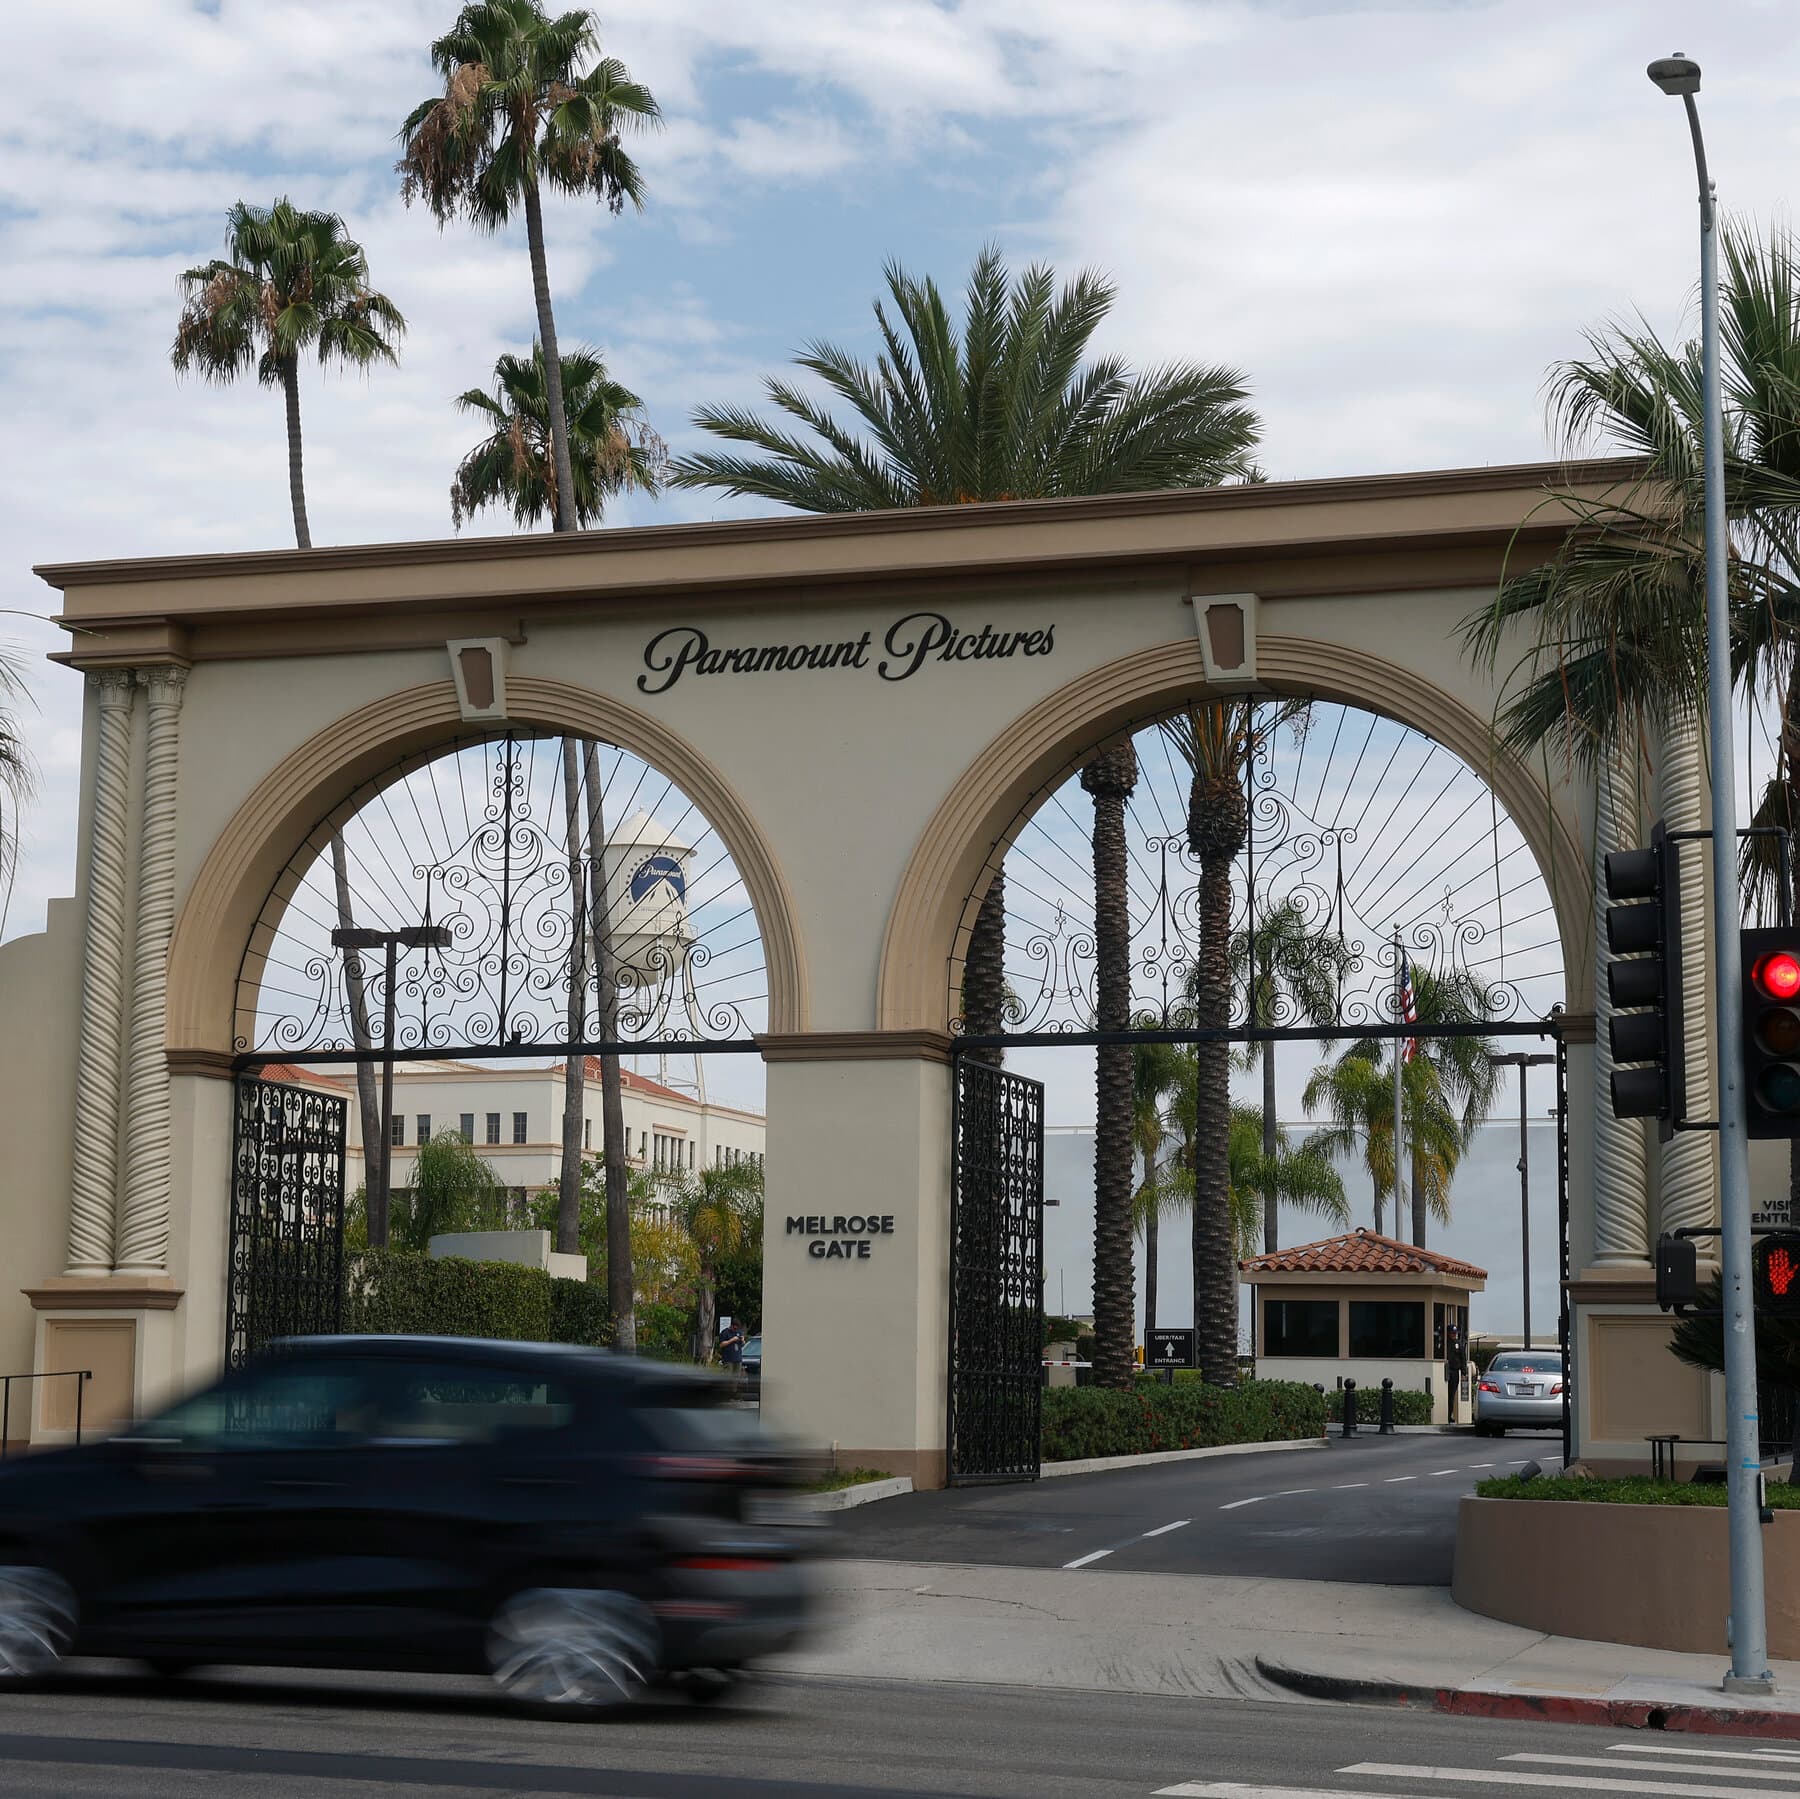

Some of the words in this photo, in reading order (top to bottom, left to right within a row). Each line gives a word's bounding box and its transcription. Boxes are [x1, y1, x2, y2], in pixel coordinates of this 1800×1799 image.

[637, 627, 871, 694] Paramount
[878, 612, 1055, 681] Pictures
[1763, 1200, 1791, 1210] VISI
[786, 1216, 894, 1234] MELROSE
[1751, 1213, 1790, 1223] ENTR
[808, 1240, 871, 1258] GATE
